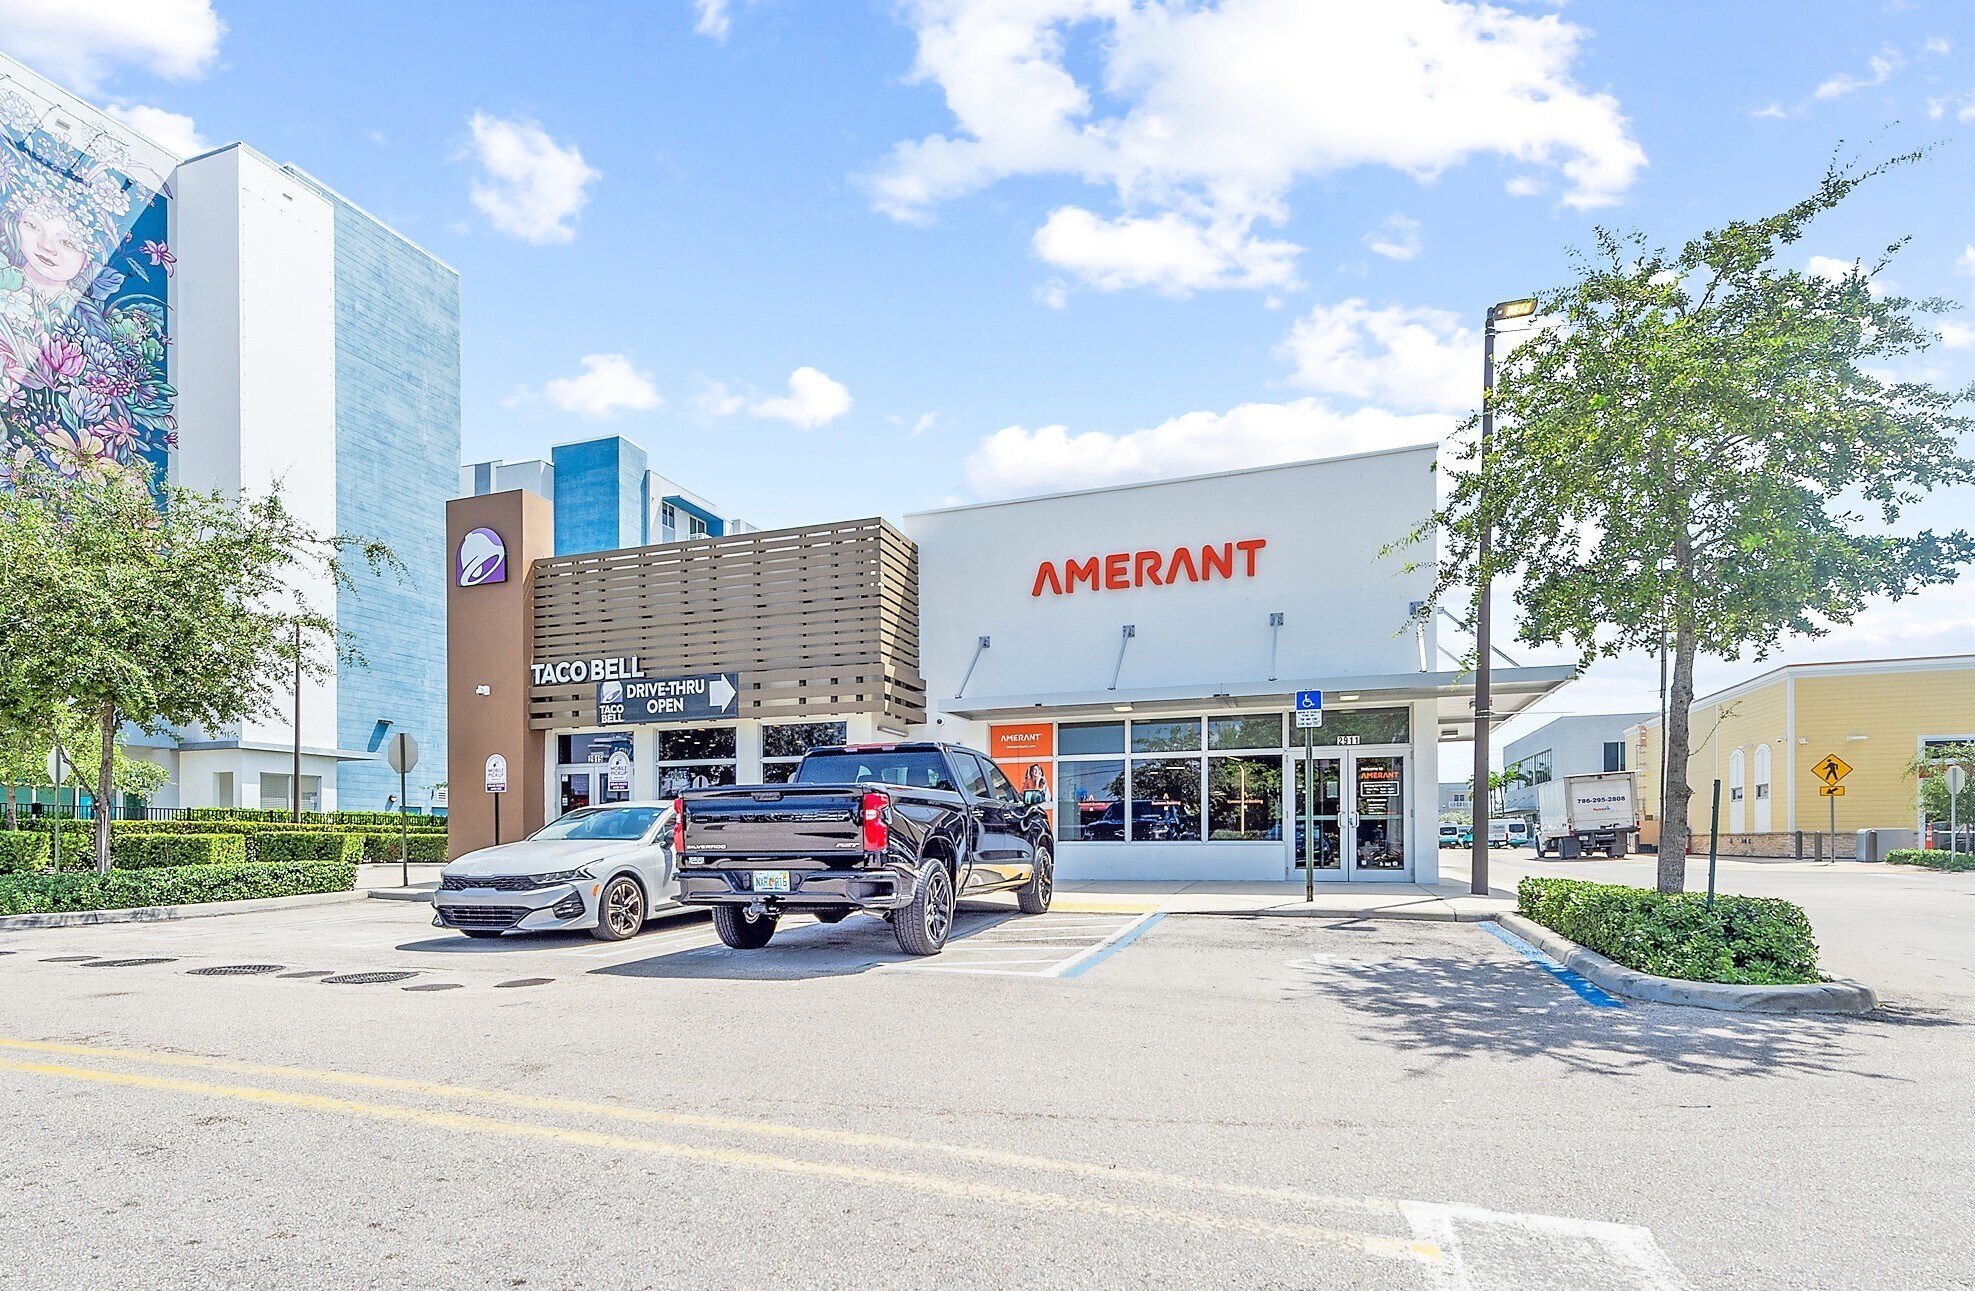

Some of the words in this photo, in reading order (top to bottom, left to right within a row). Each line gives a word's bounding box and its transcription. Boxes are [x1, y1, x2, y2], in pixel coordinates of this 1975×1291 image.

[1032, 539, 1266, 597] AMERANT
[531, 660, 588, 685] TACO
[590, 656, 645, 681] BELL
[626, 679, 705, 699] DRIVE-THRU
[599, 704, 625, 715] TACO
[646, 697, 684, 714] OPEN
[601, 714, 625, 723] BELL
[1001, 734, 1041, 742] AMERANT
[1337, 735, 1360, 745] 2911
[1577, 796, 1626, 804] 786-295-2808
